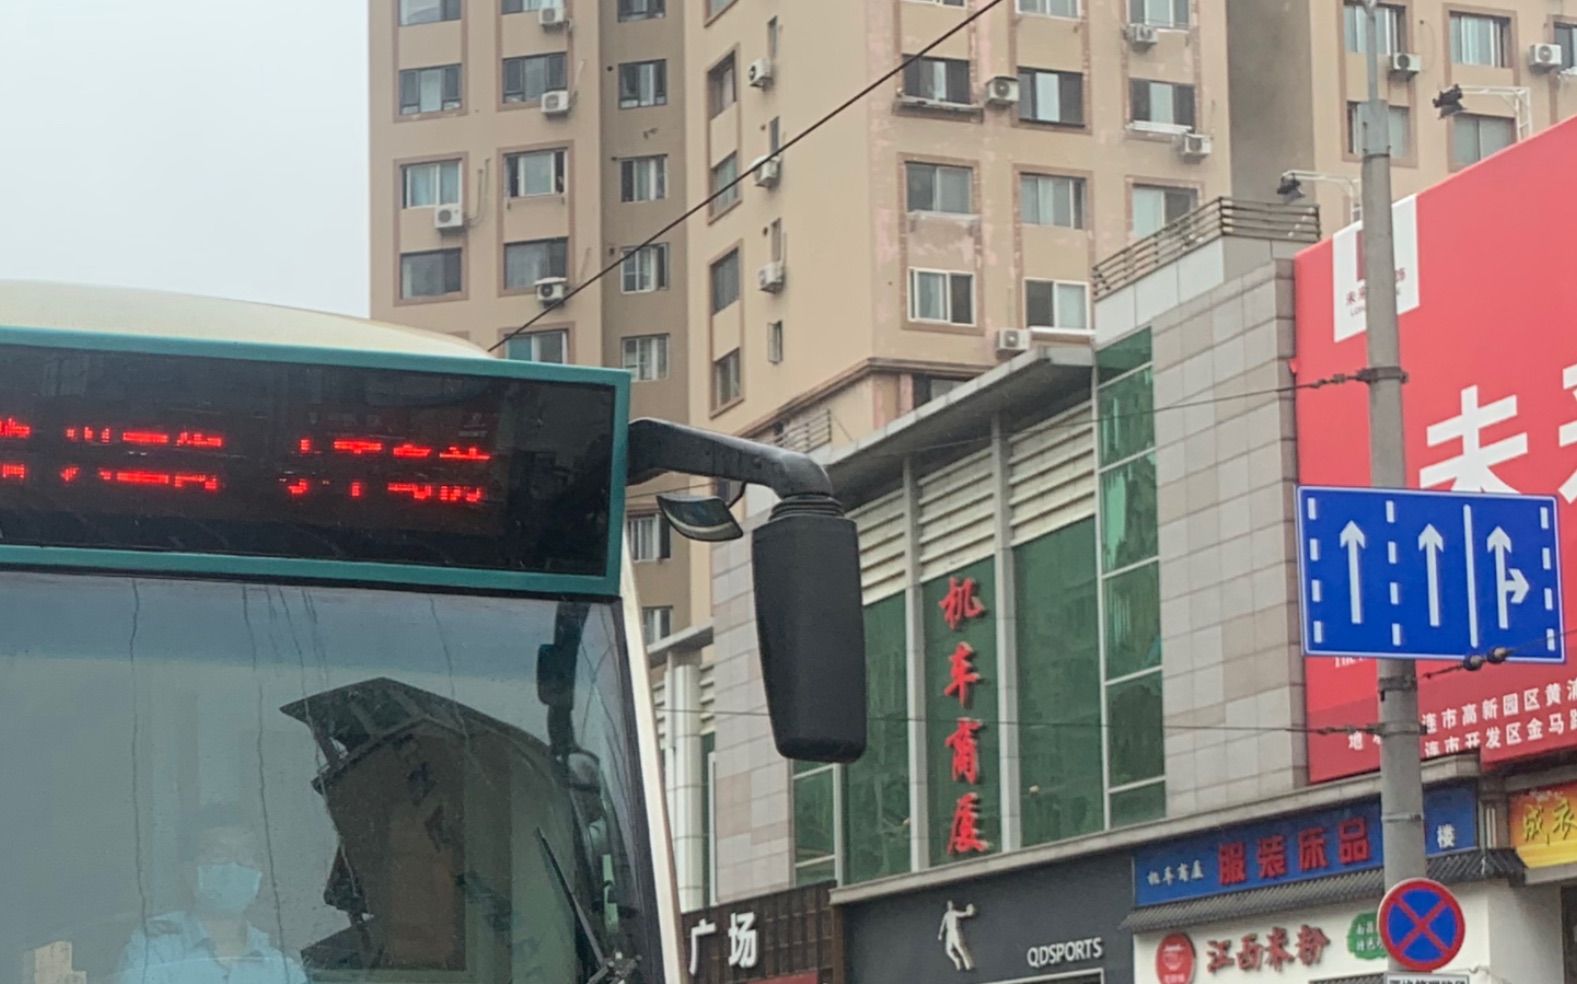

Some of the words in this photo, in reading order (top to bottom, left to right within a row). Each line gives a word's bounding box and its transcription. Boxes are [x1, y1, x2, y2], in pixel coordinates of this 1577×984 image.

[1218, 817, 1371, 885] 服装床品
[1026, 937, 1103, 968] QDSPORTS
[1206, 924, 1331, 975] 江西米粉
